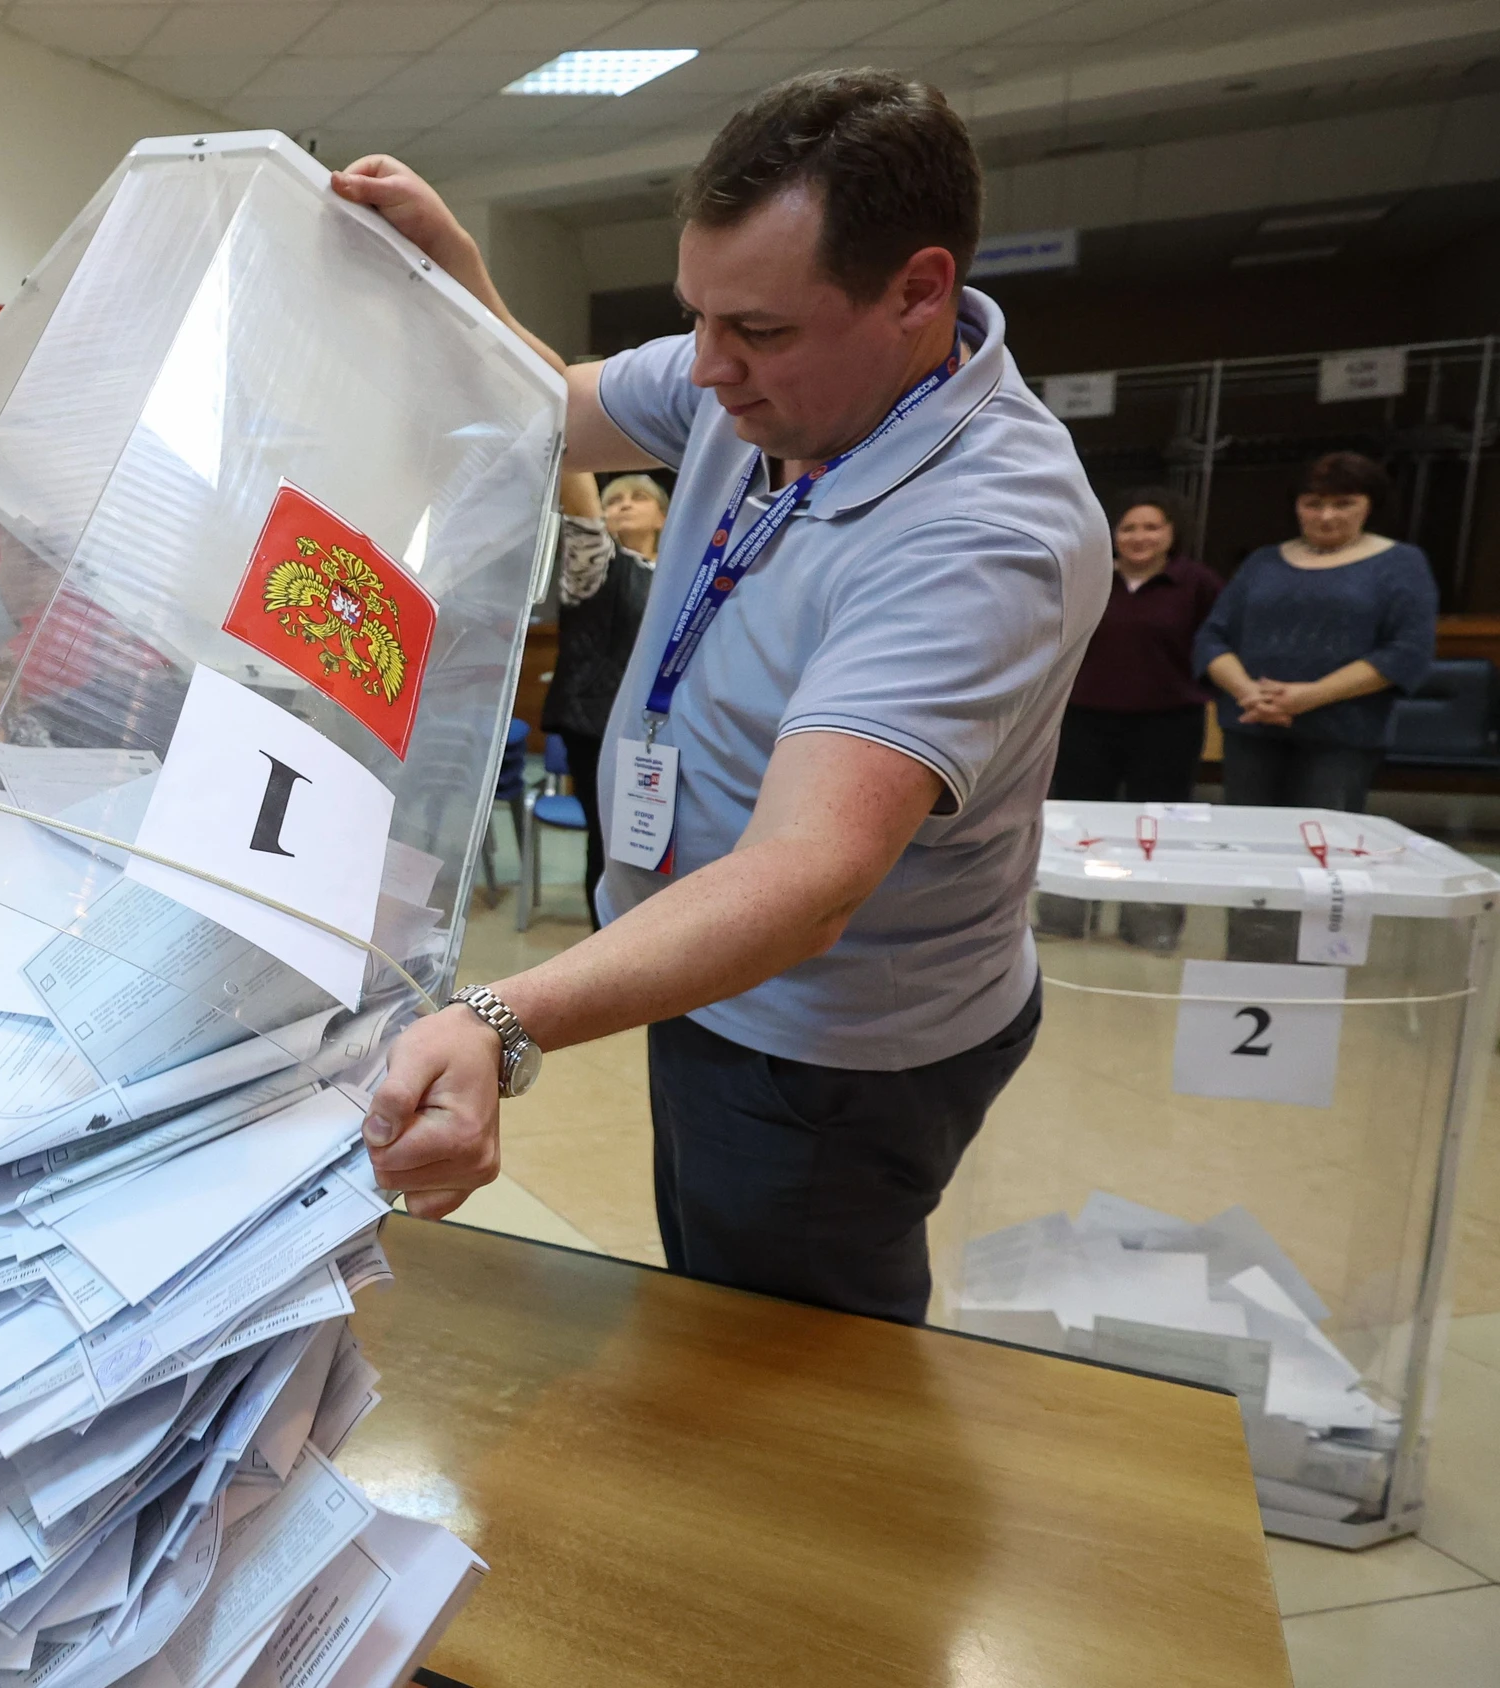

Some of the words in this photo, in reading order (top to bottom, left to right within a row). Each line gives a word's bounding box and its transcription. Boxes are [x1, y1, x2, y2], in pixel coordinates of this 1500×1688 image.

[895, 375, 940, 413] КОМИССИЯ
[727, 518, 769, 570] ИЗБИРАТЕЛЬНАЯ
[765, 484, 799, 521] КОМИССИЯ
[740, 525, 775, 569] МОСКОВСКОЙ
[770, 497, 797, 529] ОБЛАСТИ
[684, 564, 709, 612] МОСКОВСКОЙ
[671, 610, 690, 643] ОБЛАСТИ
[1230, 1006, 1273, 1057] 2
